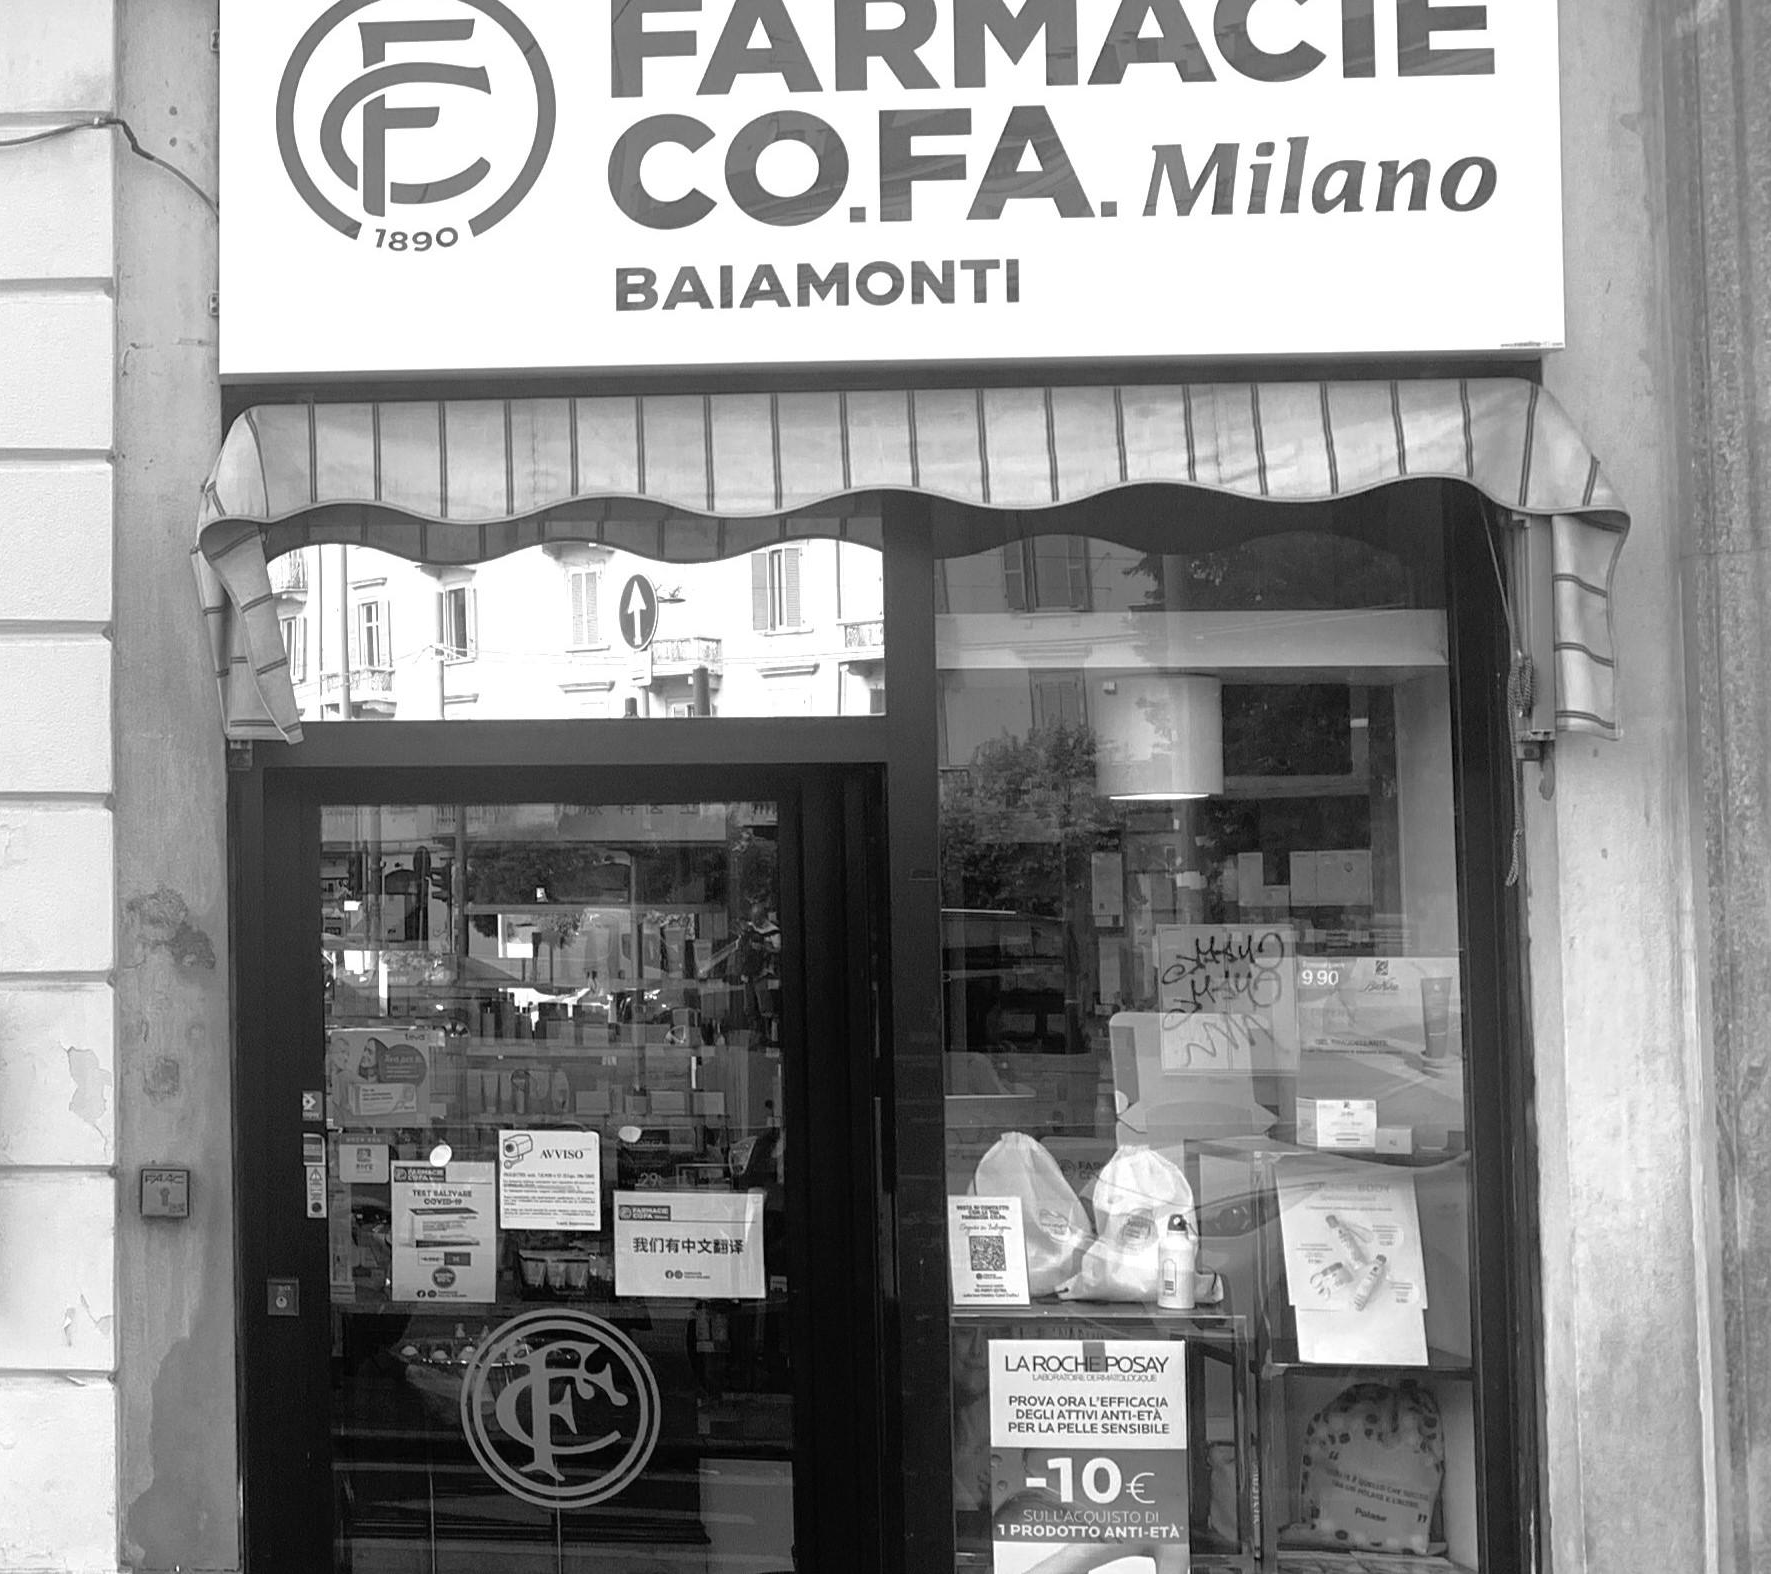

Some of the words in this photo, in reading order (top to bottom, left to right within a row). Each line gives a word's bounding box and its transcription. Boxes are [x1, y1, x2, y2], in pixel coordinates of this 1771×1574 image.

[609, 0, 1496, 98] FARMACIE
[607, 105, 1118, 230] CO.FA.
[1142, 136, 1500, 218] Milano
[372, 224, 460, 253] 1890
[614, 257, 1021, 312] BAIAMONTI
[540, 1149, 583, 1160] AVVISO
[412, 1189, 432, 1197] TEST
[633, 1237, 744, 1255] 我们有中文翻译
[1005, 1355, 1029, 1372] LA
[1033, 1355, 1101, 1373] ROCHE
[1105, 1356, 1170, 1373] POSAY
[1008, 1396, 1055, 1406] PROVA
[1056, 1396, 1087, 1407] ORA
[1016, 1409, 1054, 1420] DEGLI
[1056, 1409, 1098, 1420] ATTIVI
[1100, 1408, 1162, 1421] ANTI-ETÀ
[1008, 1423, 1035, 1433] PER
[1038, 1423, 1055, 1433] LA
[1057, 1423, 1098, 1434] PELLE
[1101, 1423, 1170, 1434] SENSIBILE
[1145, 1511, 1159, 1522] DI
[997, 1525, 1005, 1536] 1
[1010, 1525, 1100, 1537] PRODOTTO
